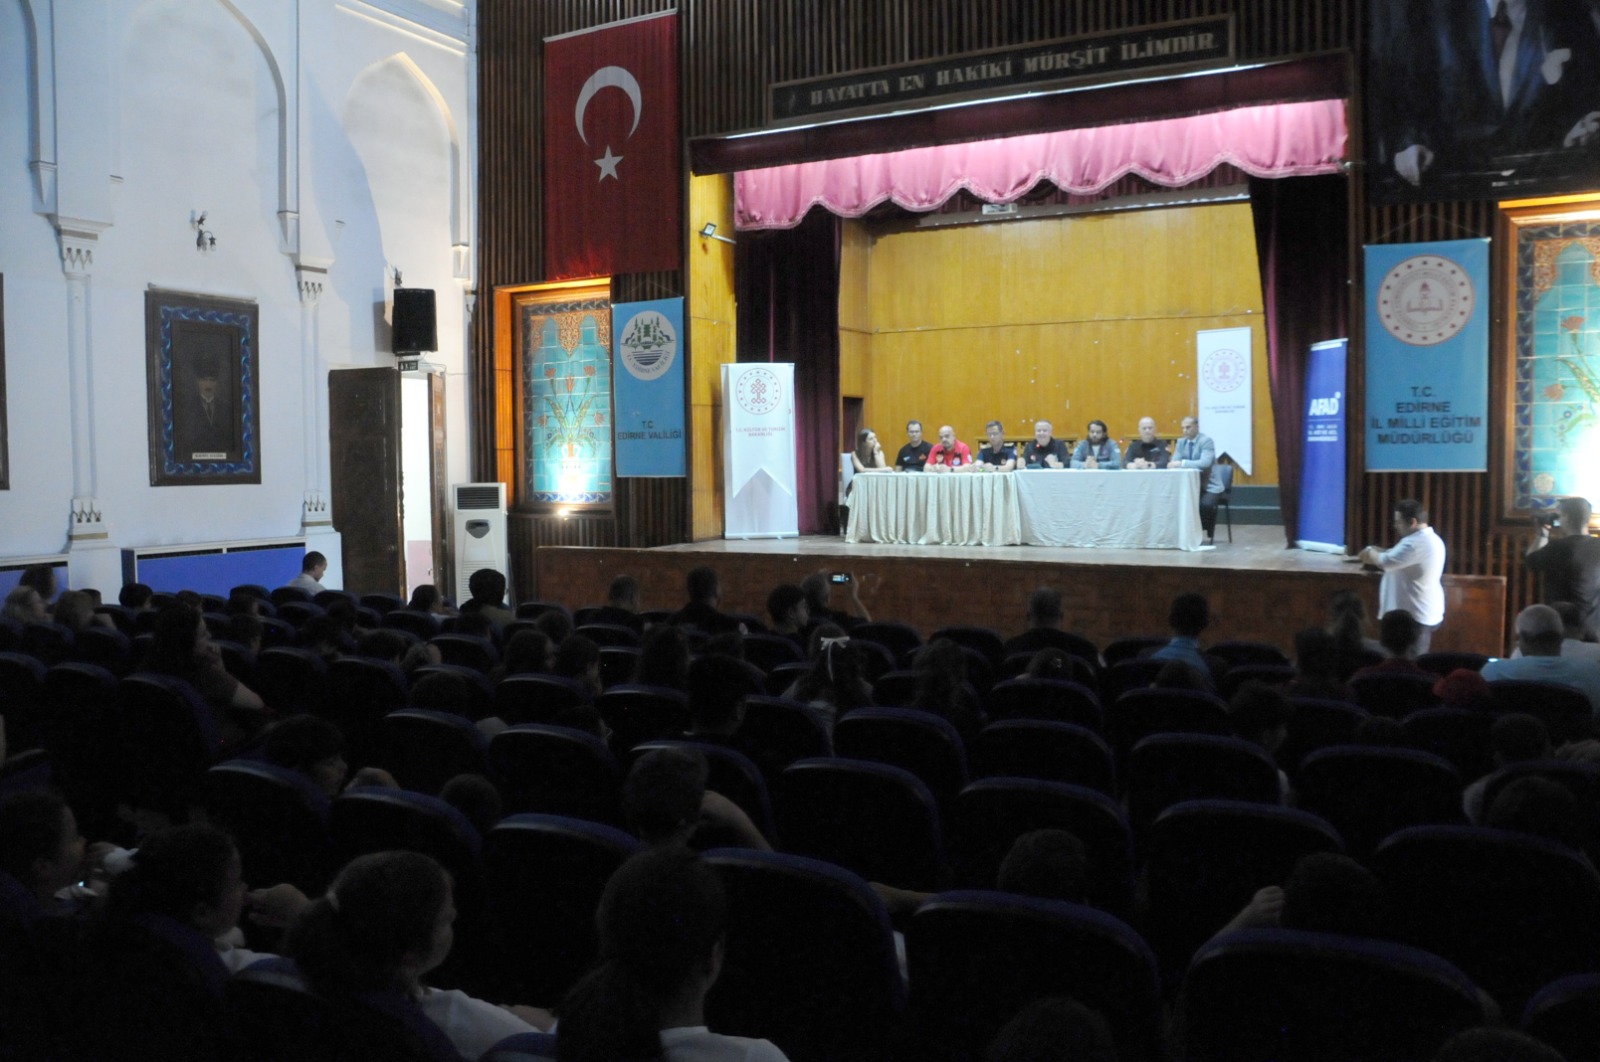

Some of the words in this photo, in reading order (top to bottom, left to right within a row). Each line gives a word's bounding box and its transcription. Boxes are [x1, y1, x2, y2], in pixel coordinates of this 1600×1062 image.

[810, 79, 890, 106] HAYATTA
[900, 74, 925, 92] EN
[936, 60, 1012, 86] HAKİKİ
[1024, 44, 1110, 74] MÜRŞİT
[1309, 397, 1339, 416] AFAD
[1396, 401, 1451, 414] EDİRNE
[1371, 415, 1383, 429] İL
[1388, 416, 1426, 429] MİLLİ
[1430, 413, 1482, 428] EĞİTİM
[617, 430, 646, 441] EDİRNE
[648, 428, 682, 440] VALİLİĞİ
[1378, 430, 1474, 445] MÜDÜRLÜĞÜ
